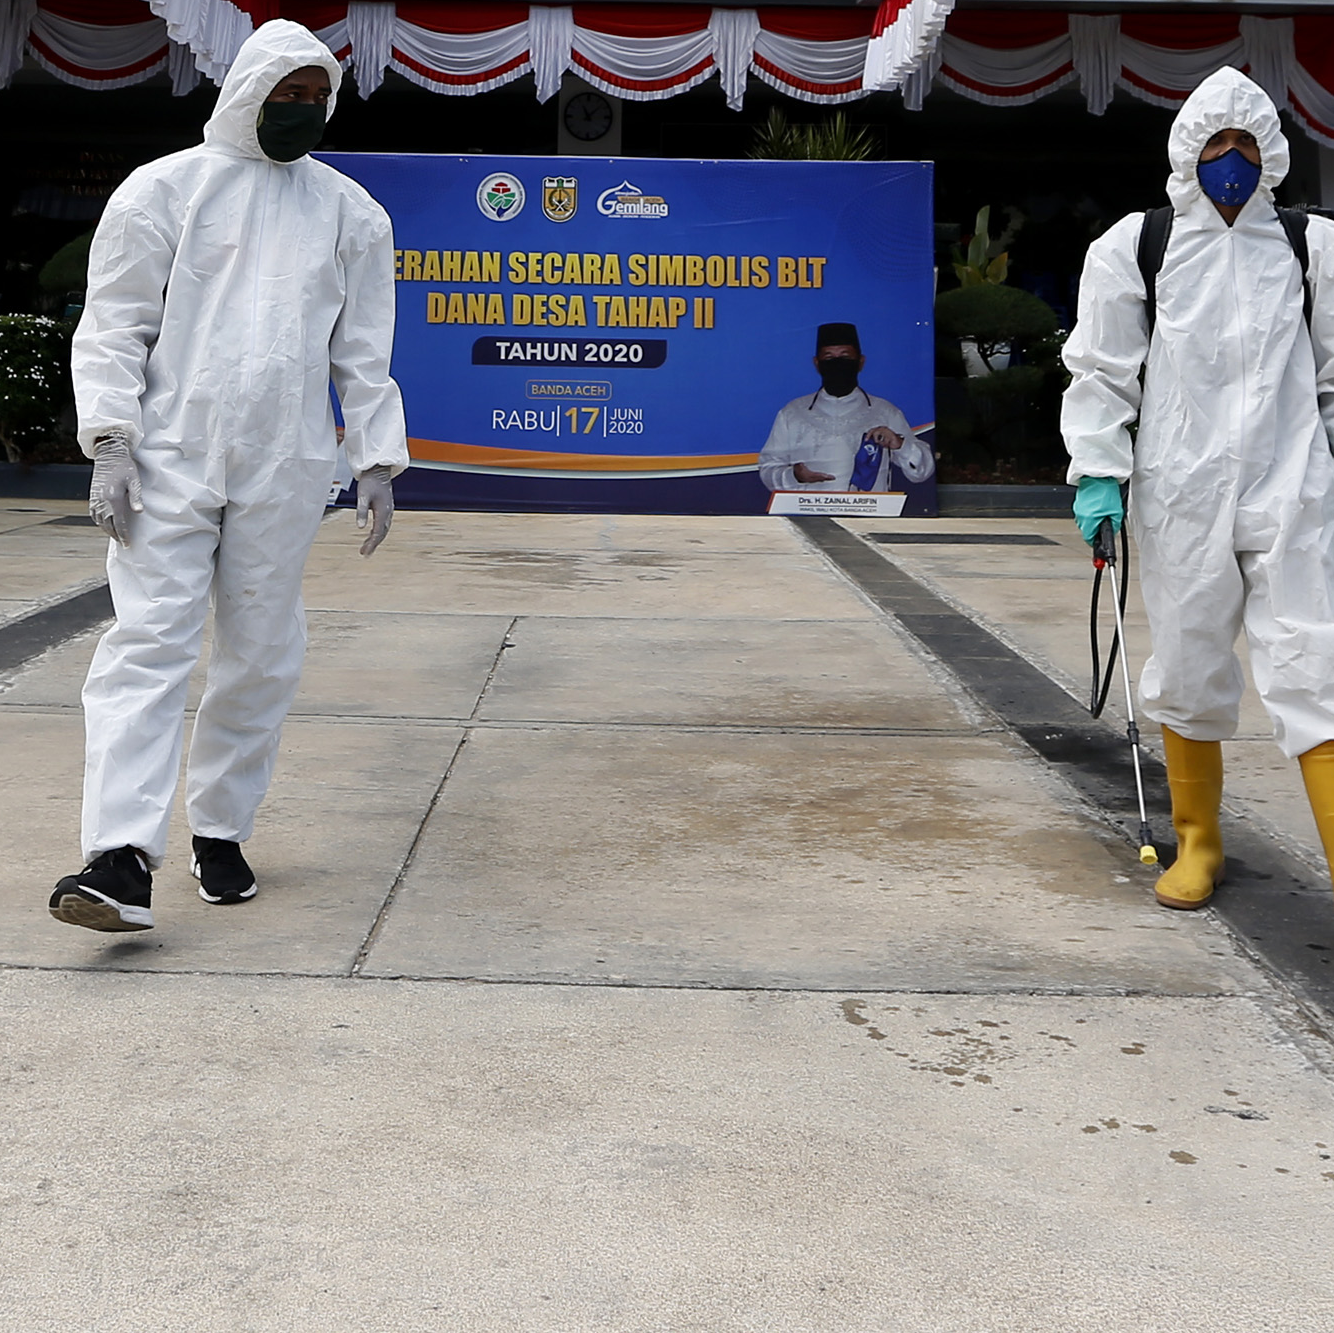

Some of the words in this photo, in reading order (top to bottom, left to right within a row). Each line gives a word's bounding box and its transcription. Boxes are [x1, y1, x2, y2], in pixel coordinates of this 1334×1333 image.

[597, 180, 669, 217] Gemilang
[508, 251, 622, 286] SECARA
[628, 253, 770, 288] SIMBOLIS
[777, 256, 827, 288] BLT
[426, 292, 506, 325] DANA
[512, 294, 587, 327] DESA
[592, 295, 687, 328] TAHAP
[693, 297, 714, 329] II
[496, 341, 578, 361] TAHUN
[584, 343, 644, 363] 2020
[531, 384, 572, 396] BANDA
[575, 385, 606, 396] ACEH
[492, 409, 556, 431] RABU
[564, 407, 600, 434] 17
[609, 408, 643, 421] JUNI
[609, 421, 644, 434] 2020
